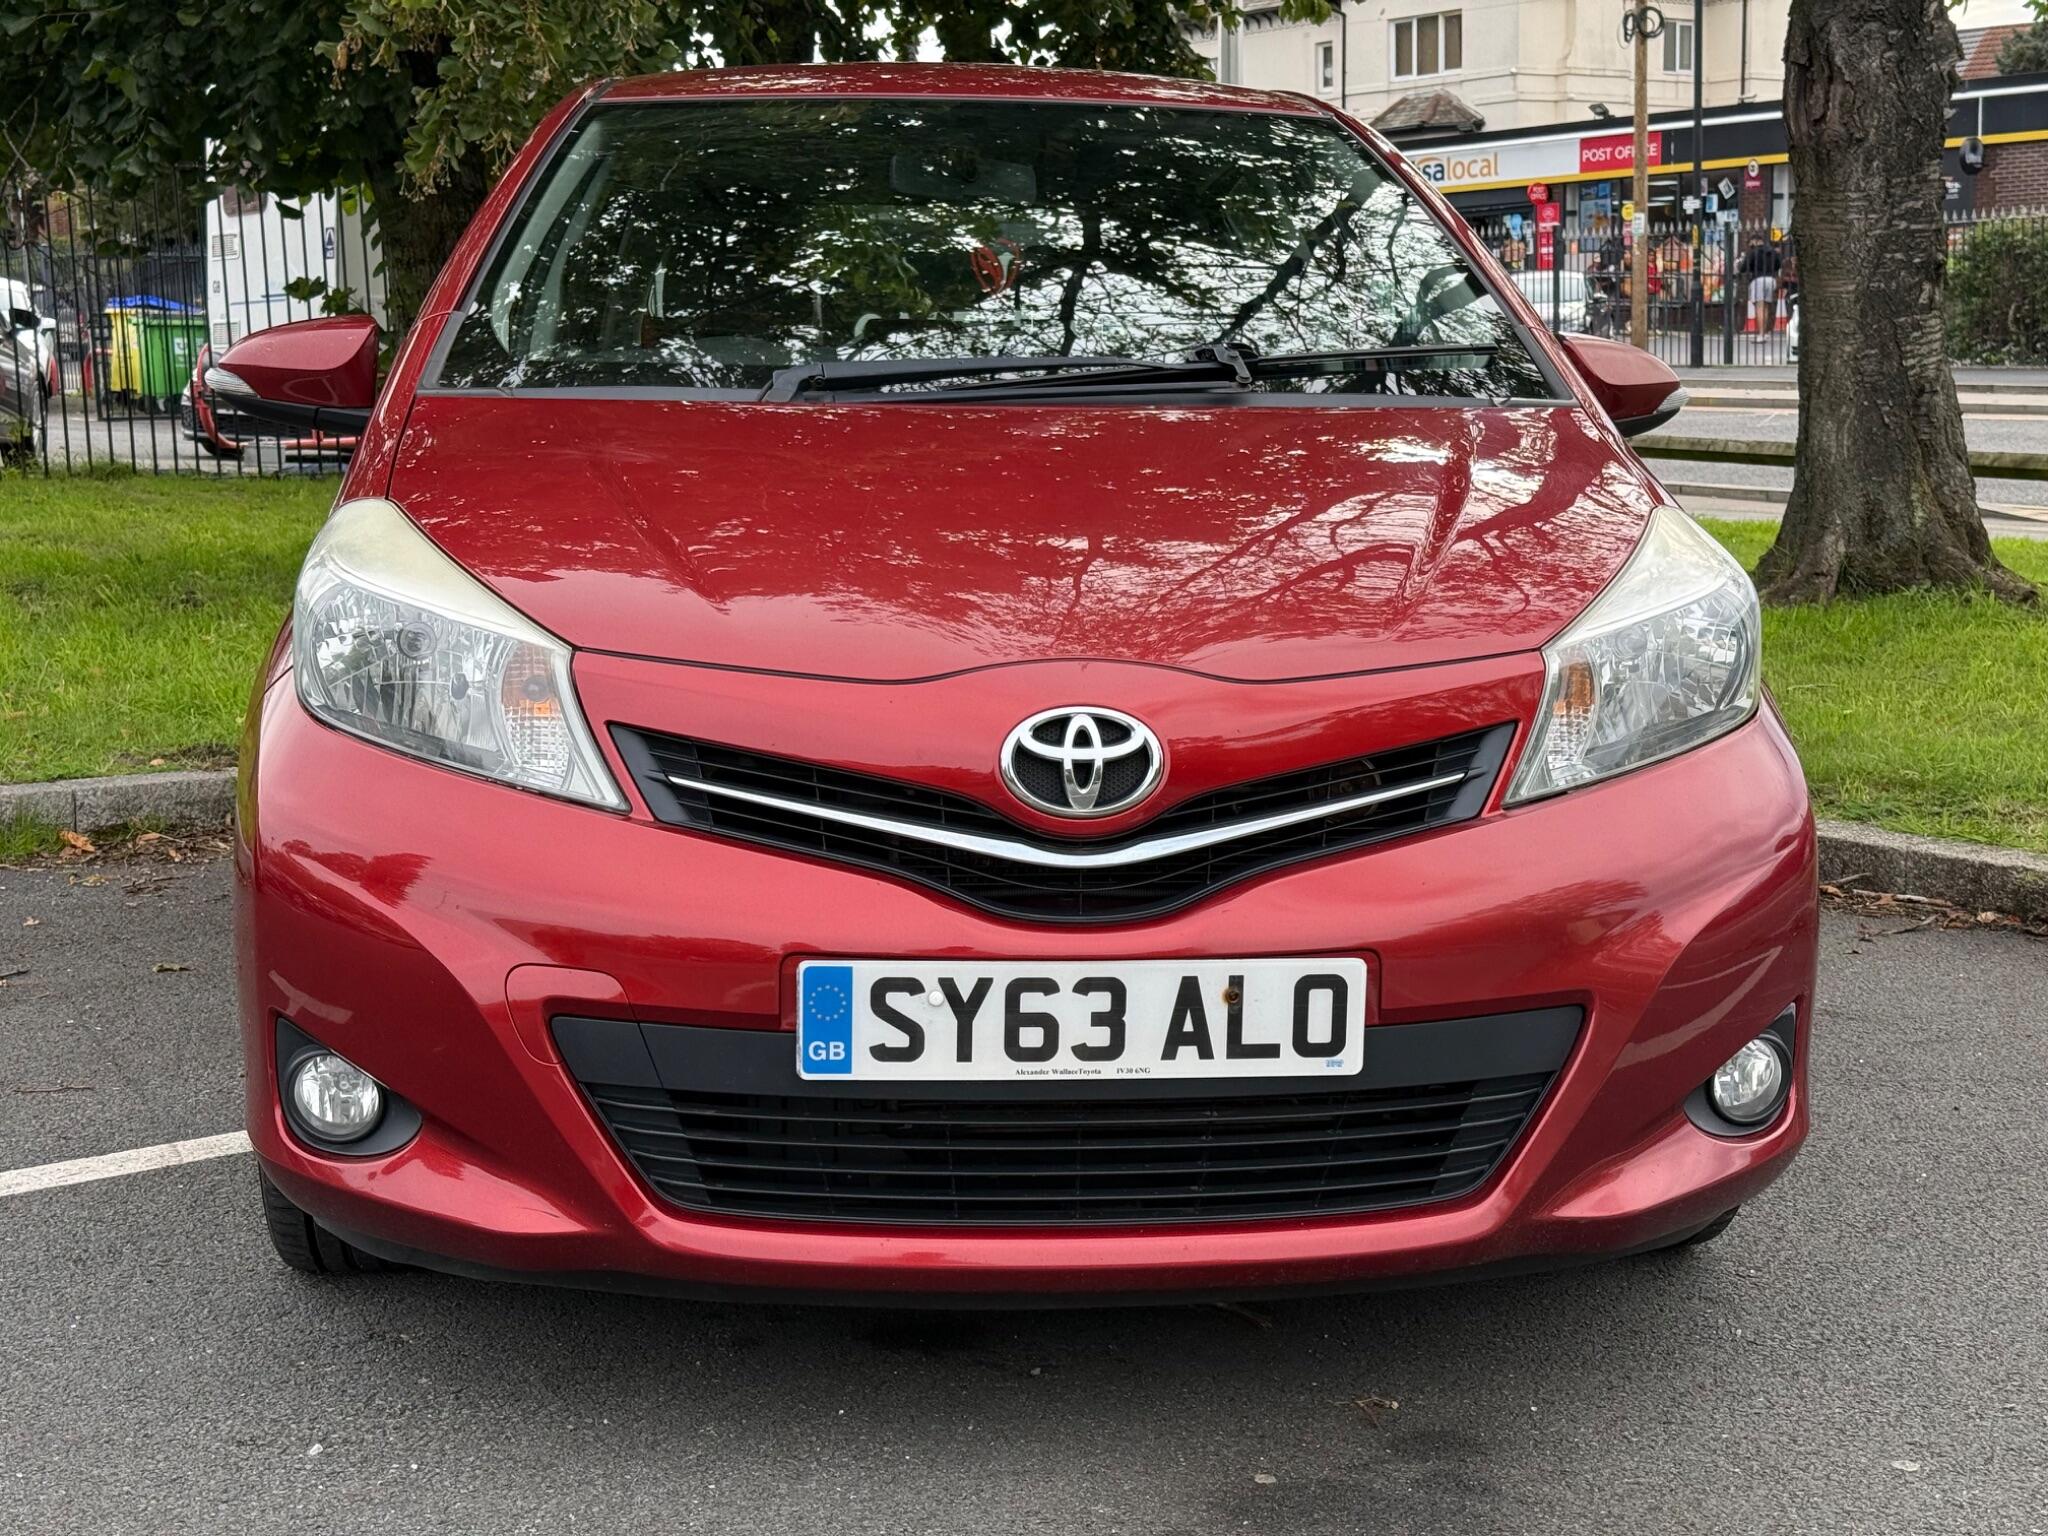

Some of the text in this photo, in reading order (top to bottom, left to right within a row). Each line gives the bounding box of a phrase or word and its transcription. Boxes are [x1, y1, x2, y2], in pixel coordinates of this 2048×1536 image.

[1582, 143, 1658, 162] POST OFE
[868, 973, 1348, 1063] SY63 ALO
[808, 1041, 846, 1061] GB
[1015, 1068, 1050, 1076] Alexander
[1134, 1066, 1151, 1074] 6NG
